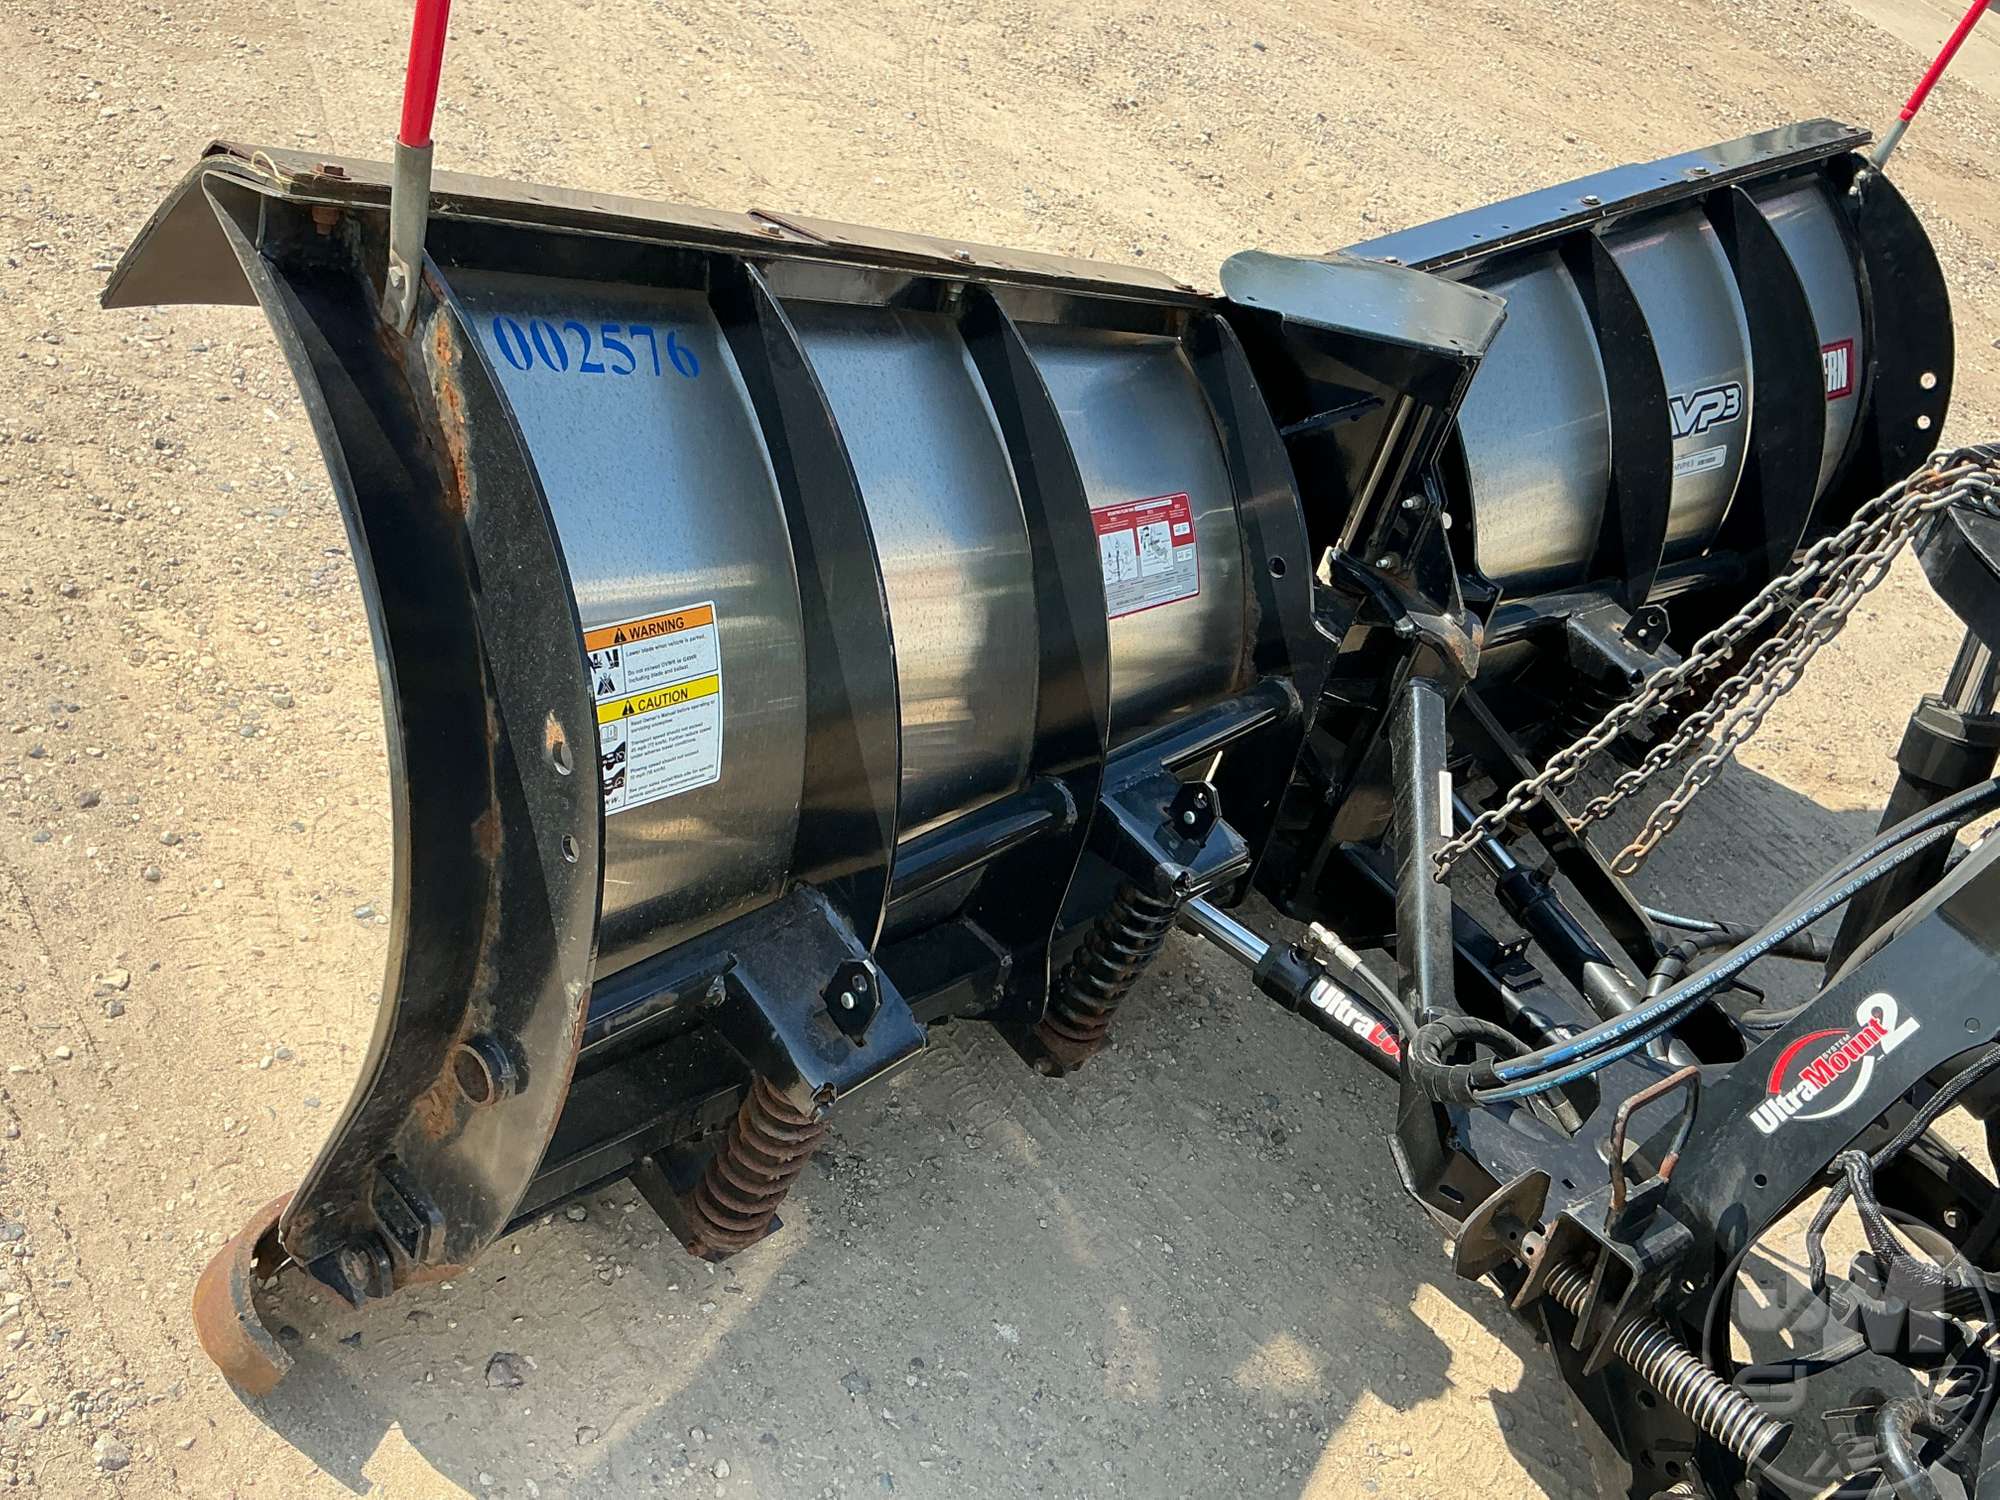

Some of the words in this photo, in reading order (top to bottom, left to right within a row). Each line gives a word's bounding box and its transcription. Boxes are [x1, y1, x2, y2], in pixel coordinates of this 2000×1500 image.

[493, 316, 700, 378] 002576
[628, 617, 685, 640] WARNING
[638, 688, 688, 712] CAUTION
[1642, 1004, 1667, 1021] DN10
[1667, 994, 1684, 1008] DIN
[1750, 941, 1770, 958] SAE
[1770, 930, 1785, 944] 100
[1823, 1033, 1851, 1060] SYSTEM
[1749, 1018, 1888, 1135] UltraMount
